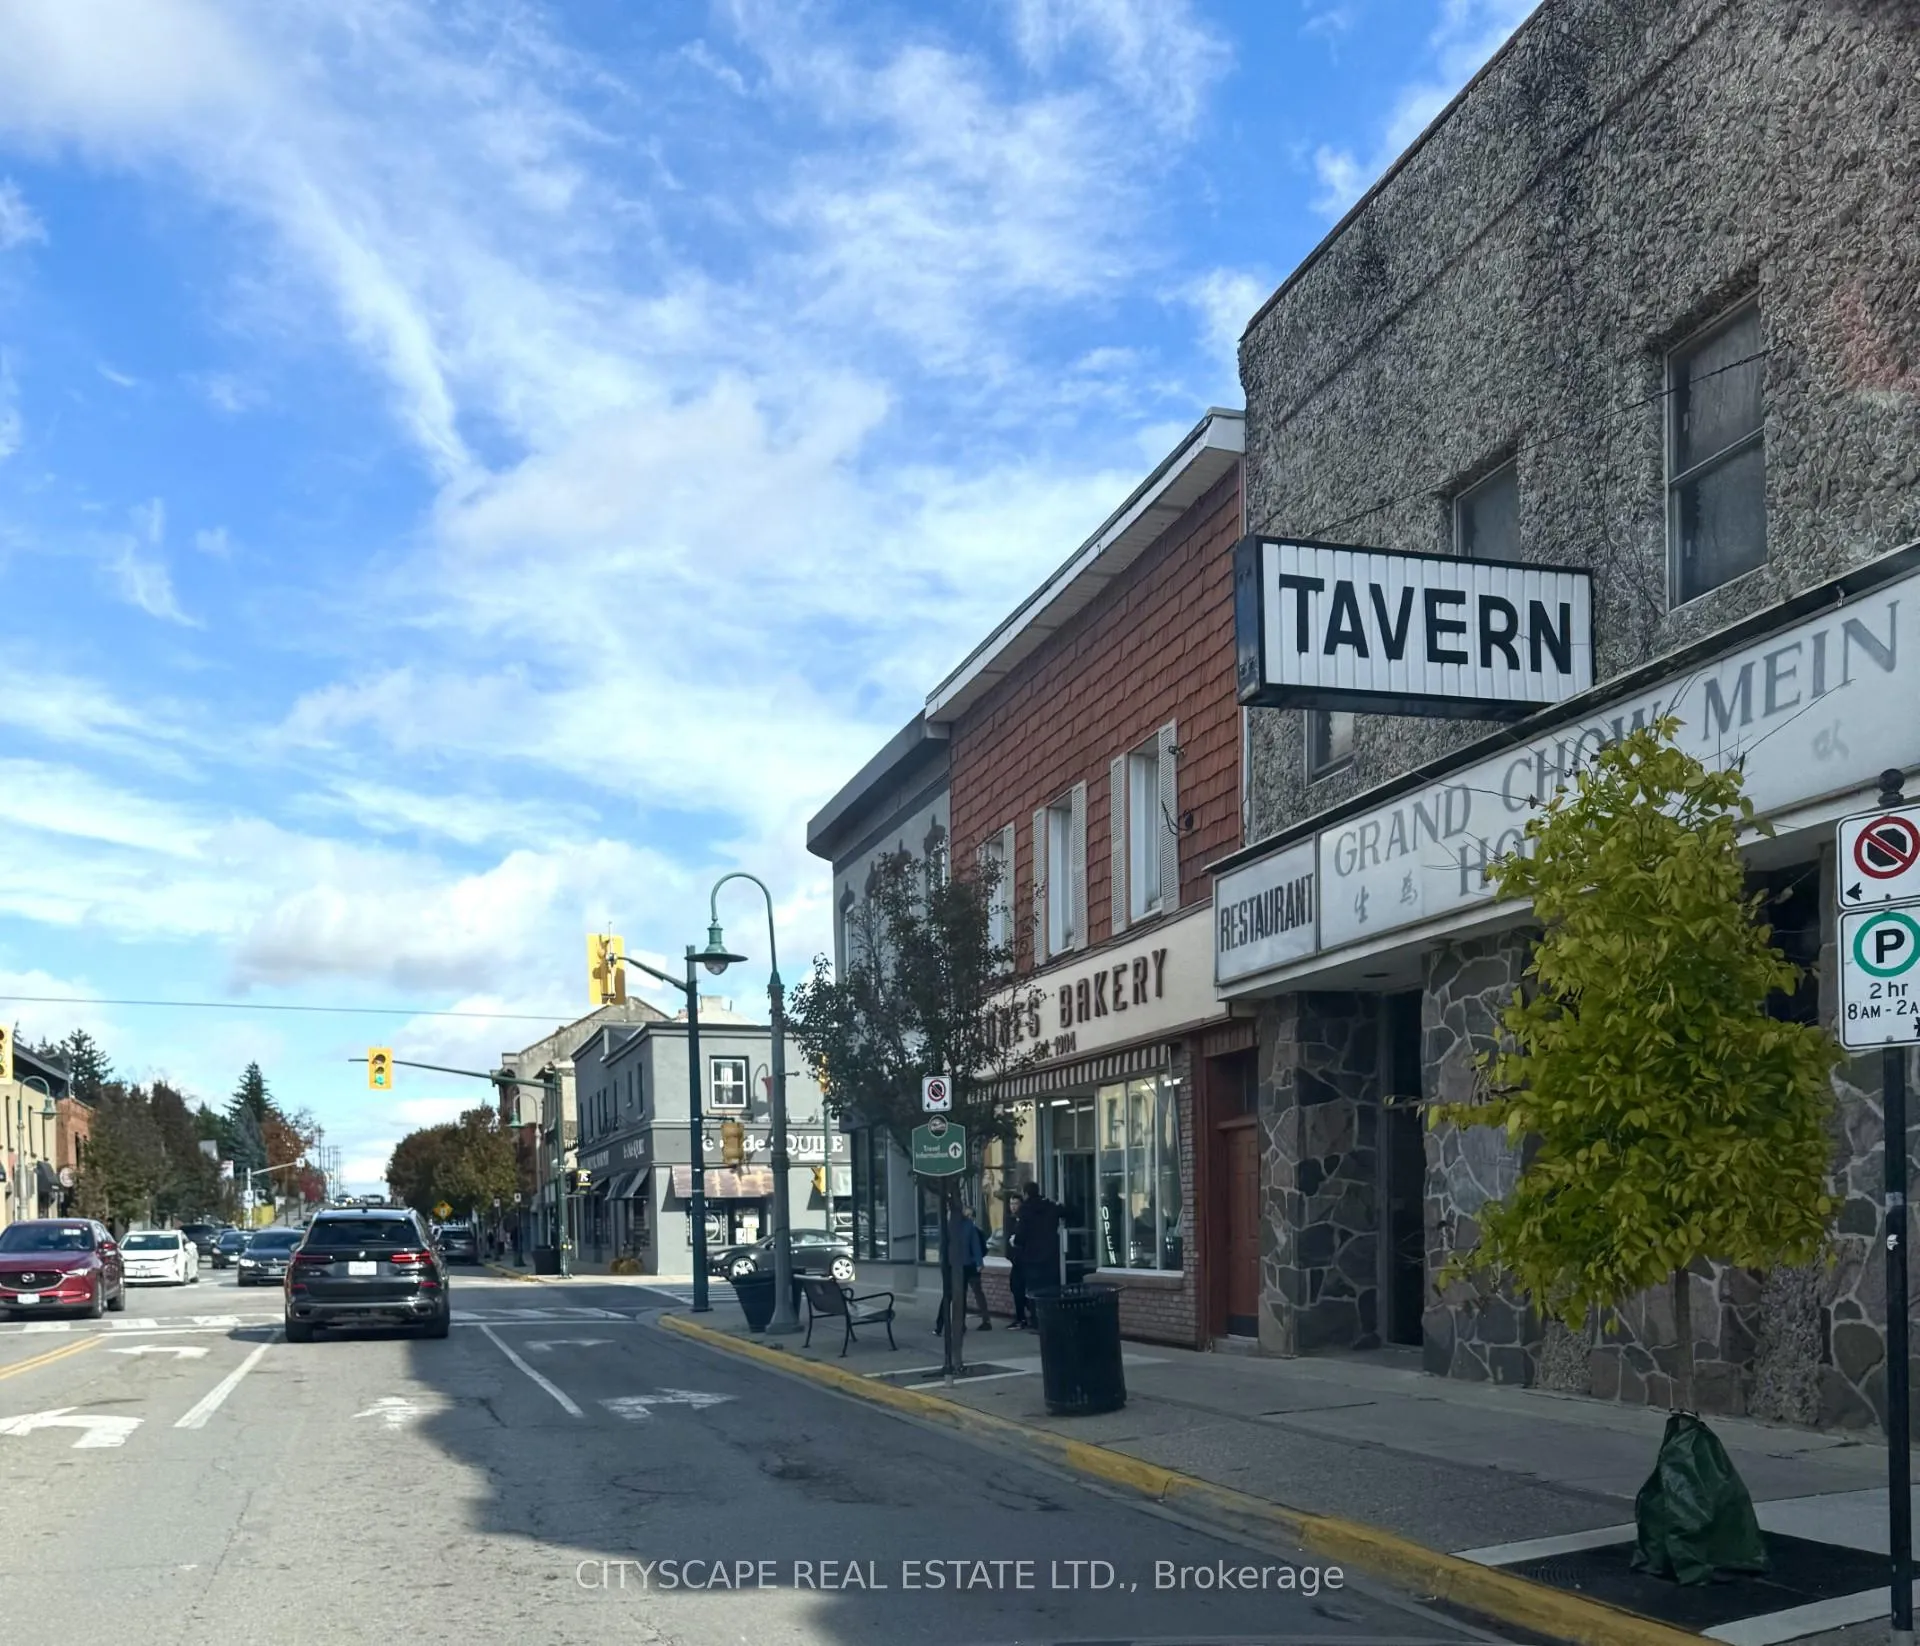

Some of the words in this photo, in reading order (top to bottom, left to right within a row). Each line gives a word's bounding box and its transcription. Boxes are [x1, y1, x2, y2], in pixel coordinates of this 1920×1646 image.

[1279, 573, 1572, 675] TAVERN
[1334, 783, 1472, 877] GRAND
[1702, 600, 1900, 741] MEIN
[1220, 873, 1314, 953] RESTAURANT
[1059, 948, 1168, 1029] BAKERY
[1870, 982, 1882, 999] 2
[1888, 981, 1909, 997] hr
[1102, 1206, 1117, 1264] OPEN
